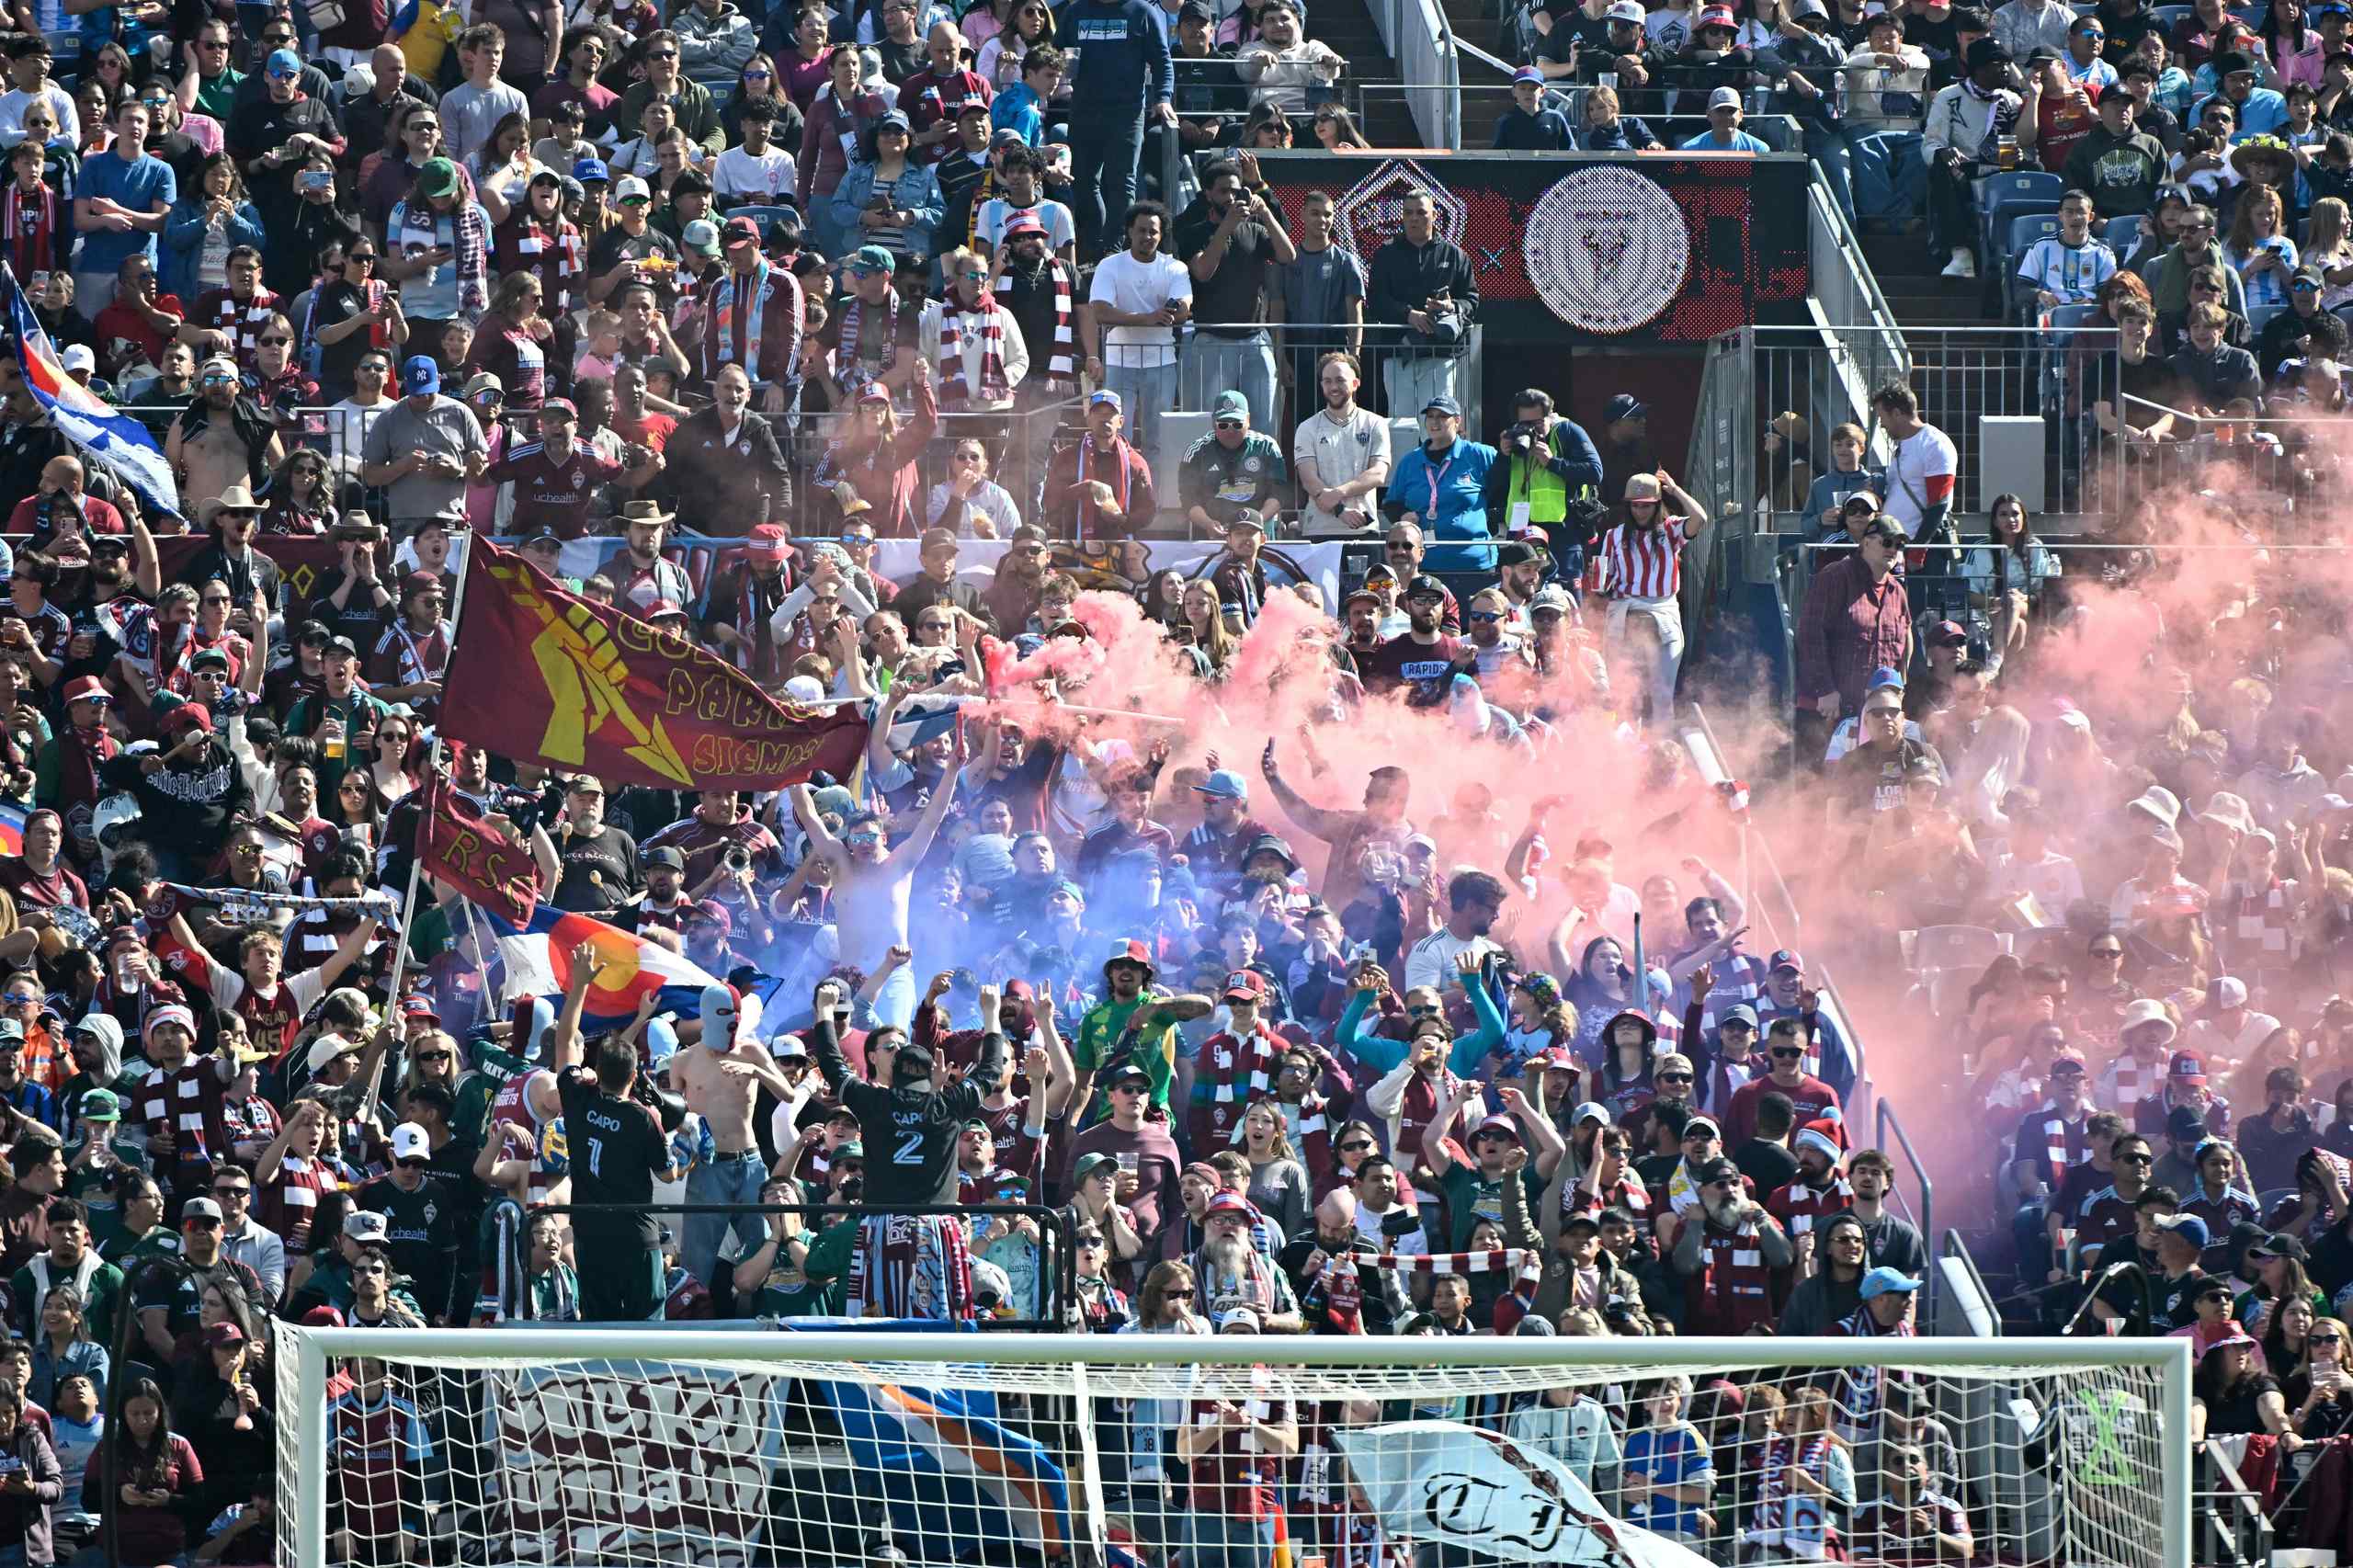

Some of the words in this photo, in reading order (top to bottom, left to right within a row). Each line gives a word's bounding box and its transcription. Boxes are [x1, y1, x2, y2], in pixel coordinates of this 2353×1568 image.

[532, 492, 580, 503] uchealth
[1408, 663, 1444, 676] RAPIDS
[254, 1028, 280, 1052] 45
[587, 1110, 620, 1131] CAPO
[588, 1137, 602, 1177] 1
[892, 1131, 924, 1164] 2
